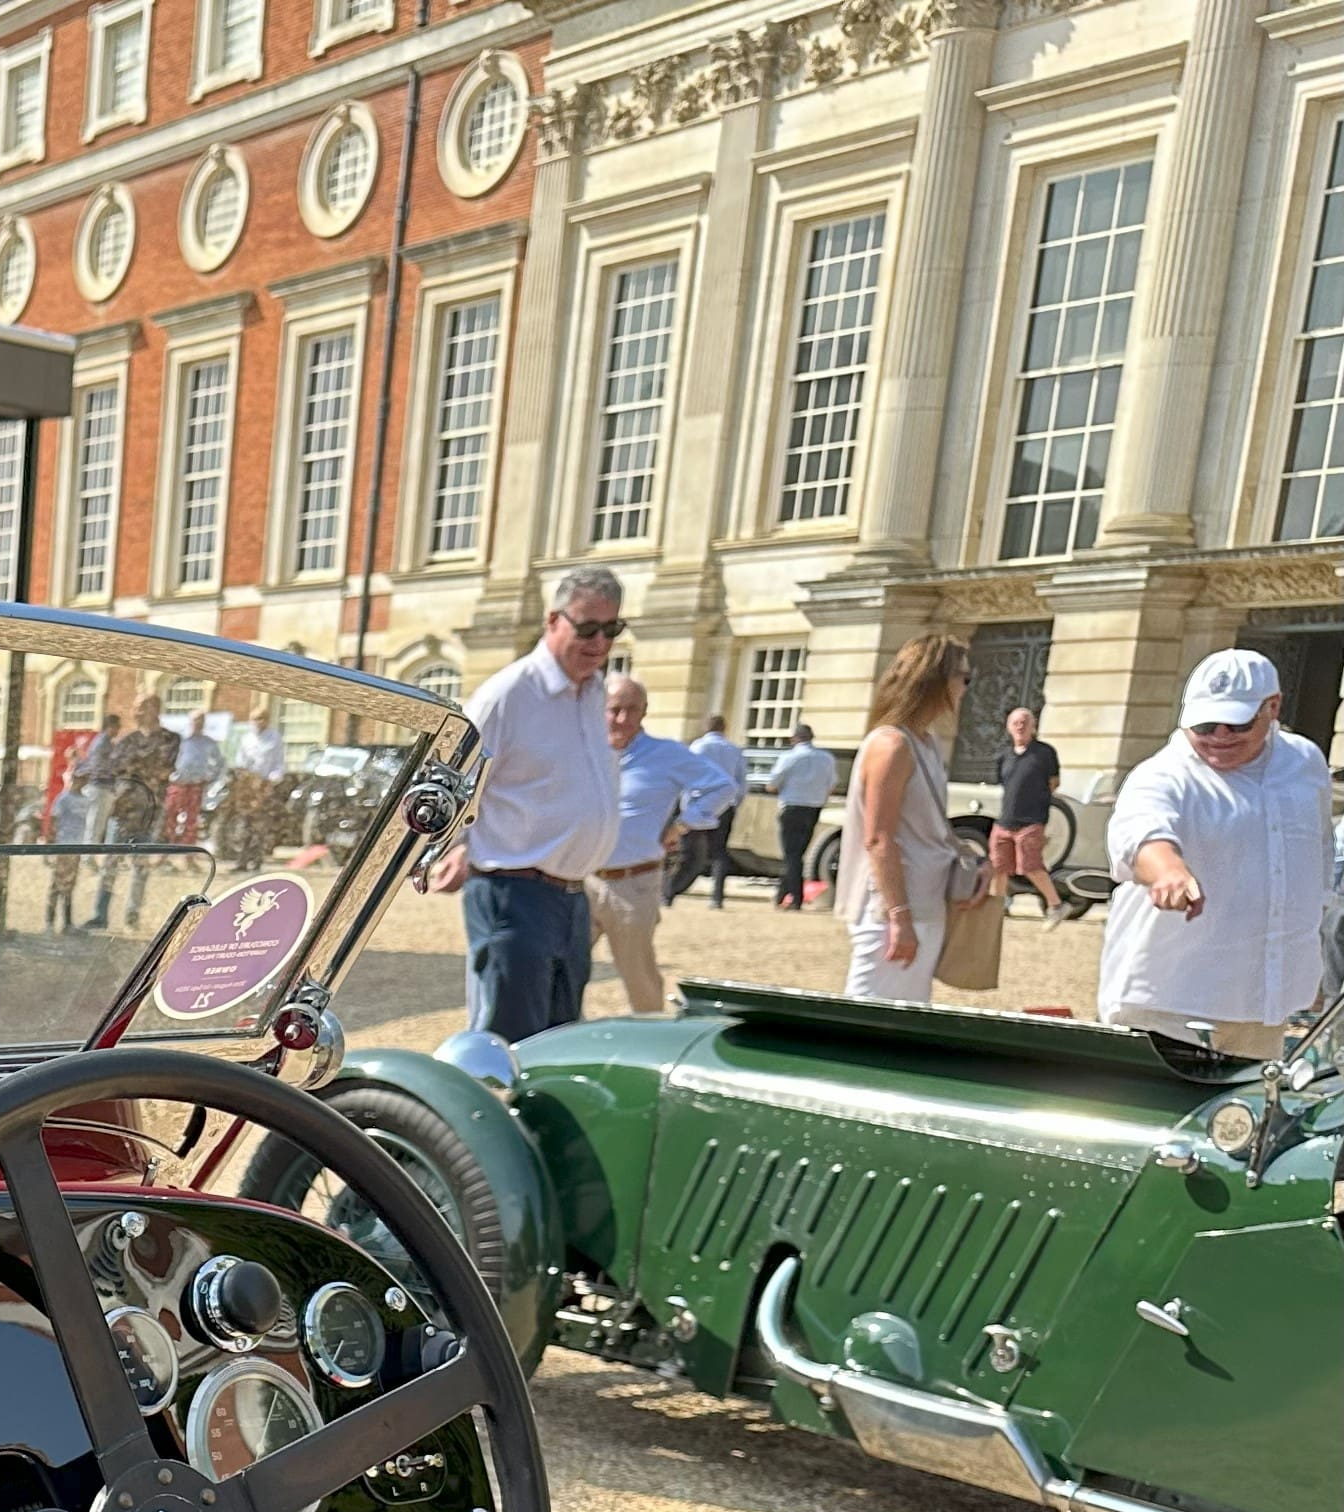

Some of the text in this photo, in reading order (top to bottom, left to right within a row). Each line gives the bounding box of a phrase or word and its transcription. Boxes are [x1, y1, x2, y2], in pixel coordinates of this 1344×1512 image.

[211, 1428, 221, 1438] 55
[392, 1482, 428, 1497] L R
